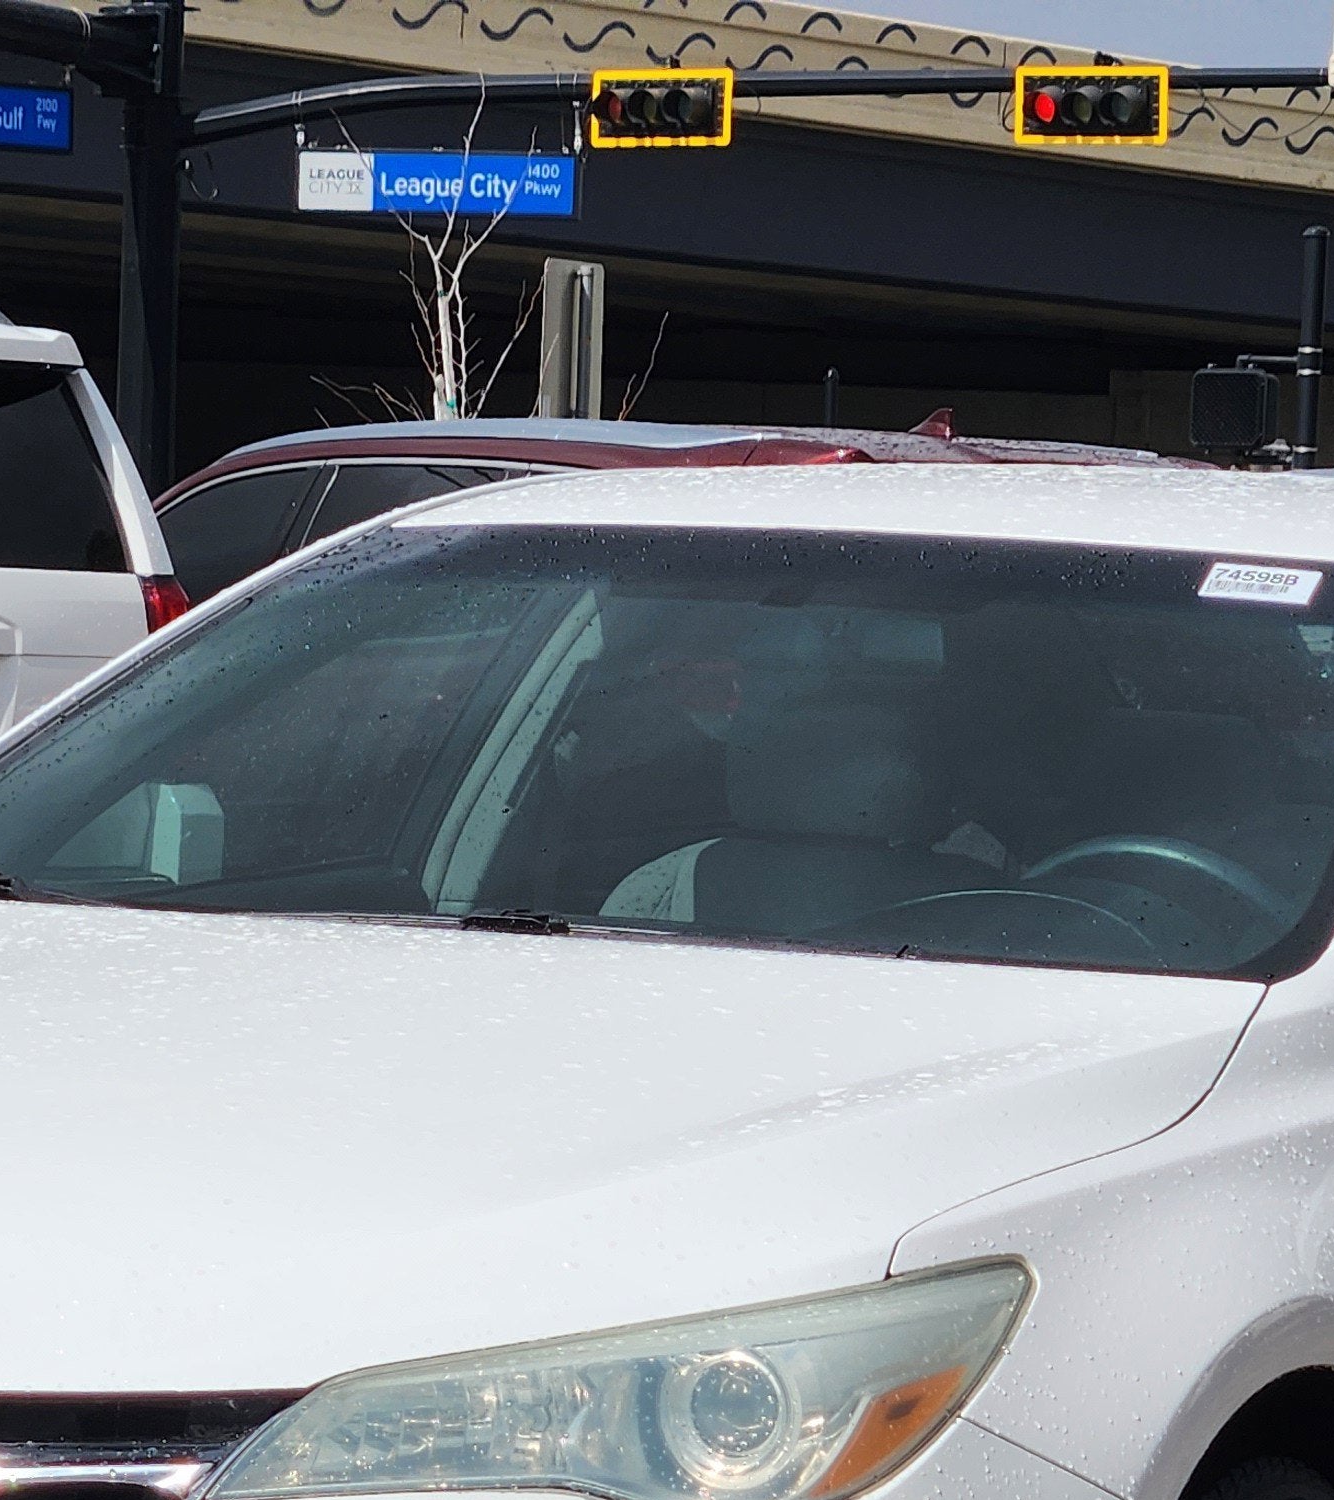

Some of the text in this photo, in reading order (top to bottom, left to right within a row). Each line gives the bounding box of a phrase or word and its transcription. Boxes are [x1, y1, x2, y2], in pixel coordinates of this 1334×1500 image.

[35, 97, 58, 113] 2100
[37, 114, 57, 133] Fwy
[309, 168, 365, 180] LEAGUE
[527, 163, 560, 179] 1400
[309, 181, 342, 194] CITY
[380, 171, 517, 204] League City
[524, 181, 562, 199] Pkwy
